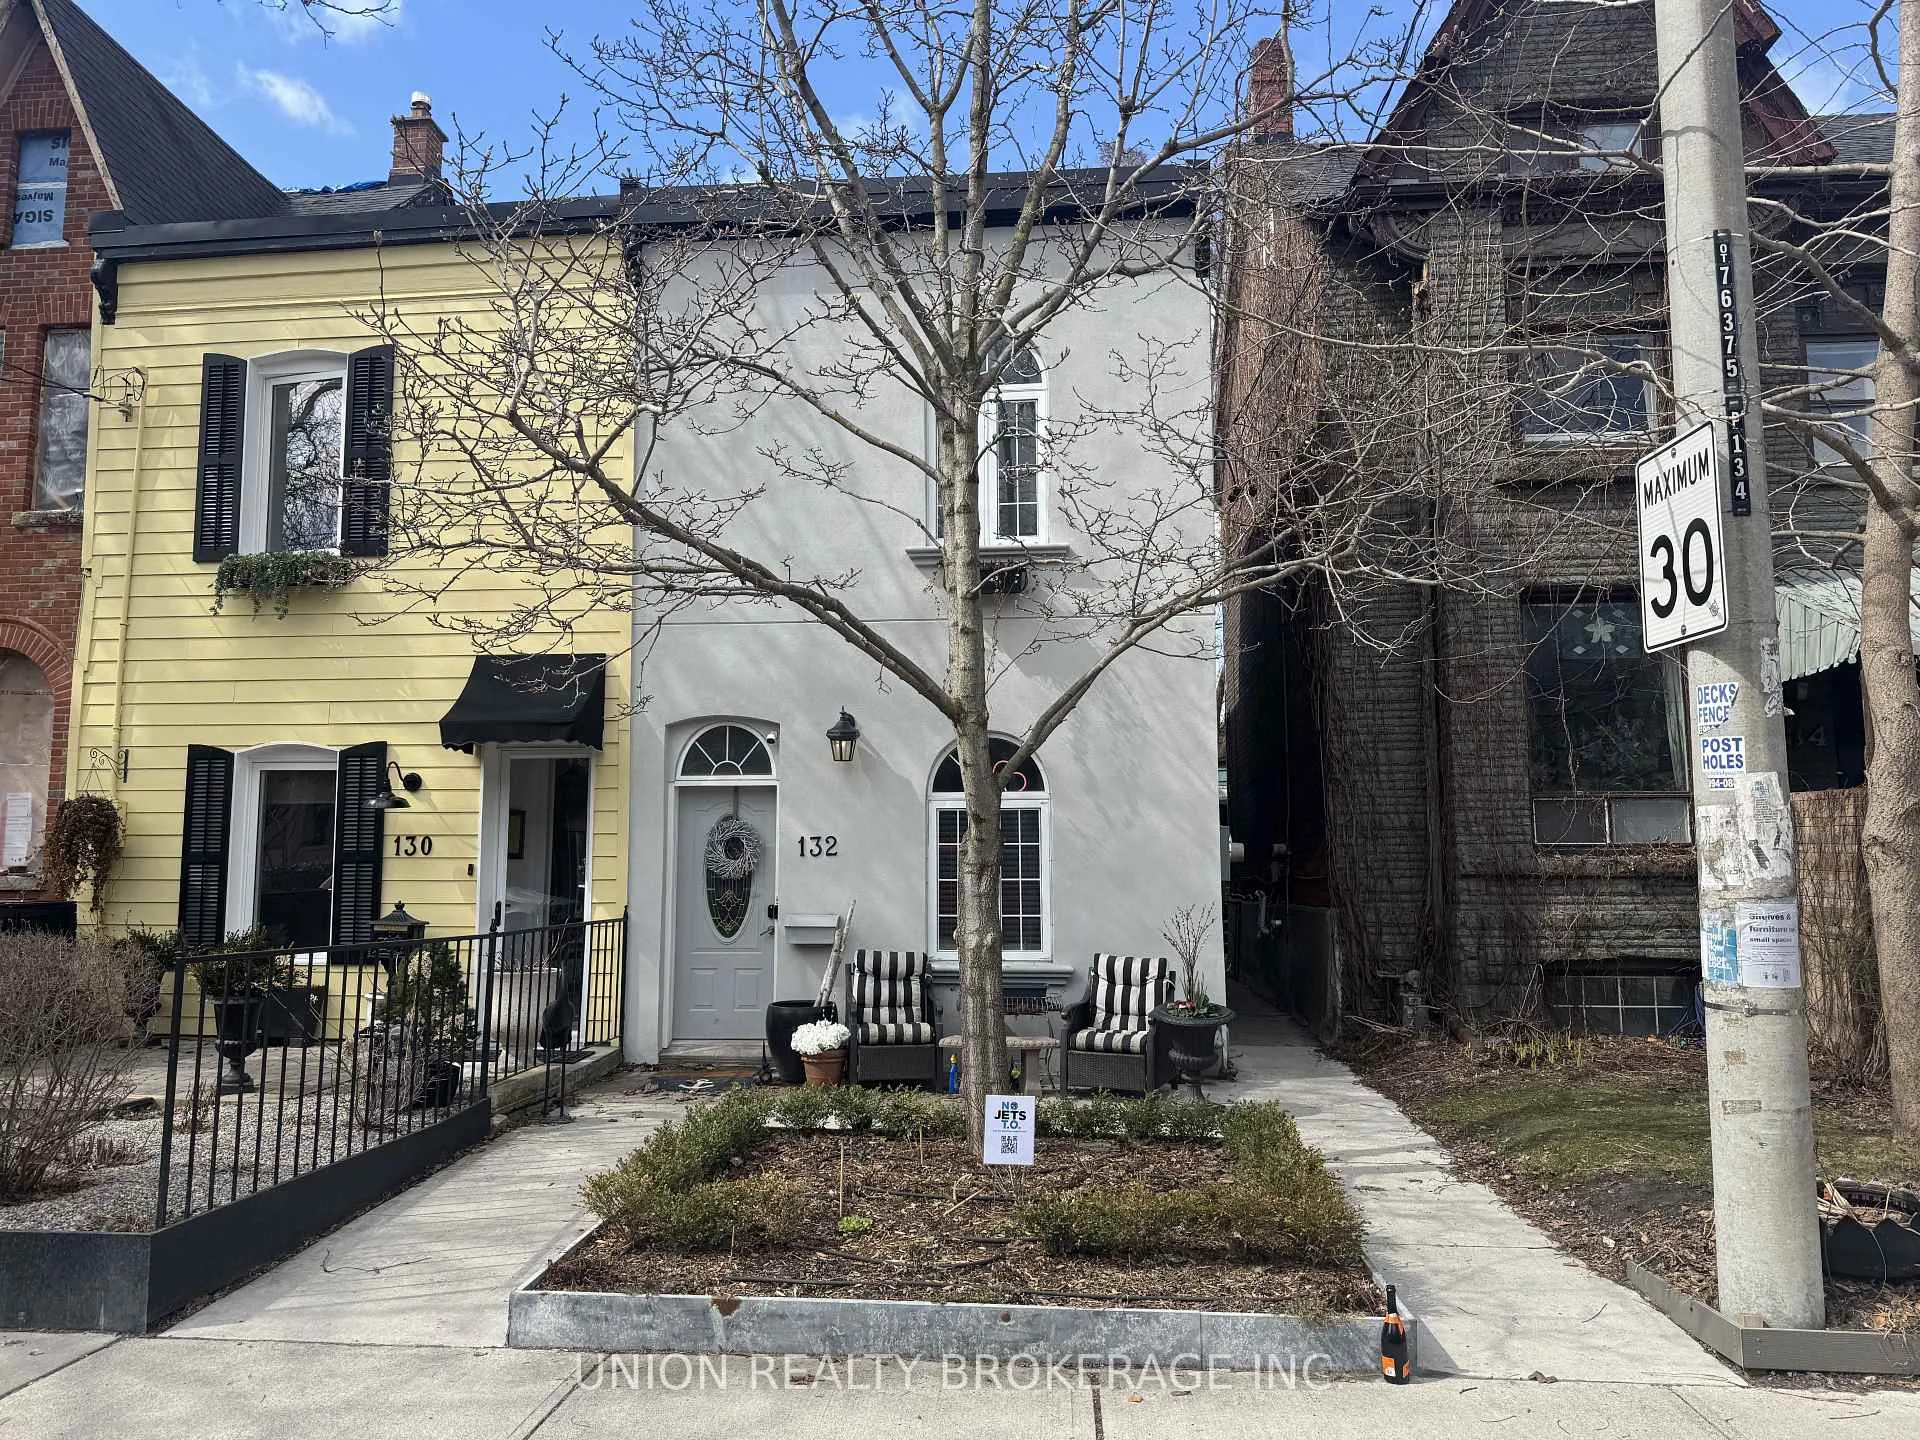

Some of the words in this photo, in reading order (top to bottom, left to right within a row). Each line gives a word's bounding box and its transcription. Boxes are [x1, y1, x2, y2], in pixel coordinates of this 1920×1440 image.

[1643, 447, 1710, 510] MAXIMUM
[1650, 517, 1714, 619] 30
[1697, 683, 1737, 705] DECKS
[1702, 737, 1743, 753] POST
[1702, 753, 1744, 770] HOLES
[394, 835, 433, 857] 130
[797, 835, 838, 857] 132
[994, 1110, 1026, 1120] JETS
[1001, 1101, 1018, 1109] NO
